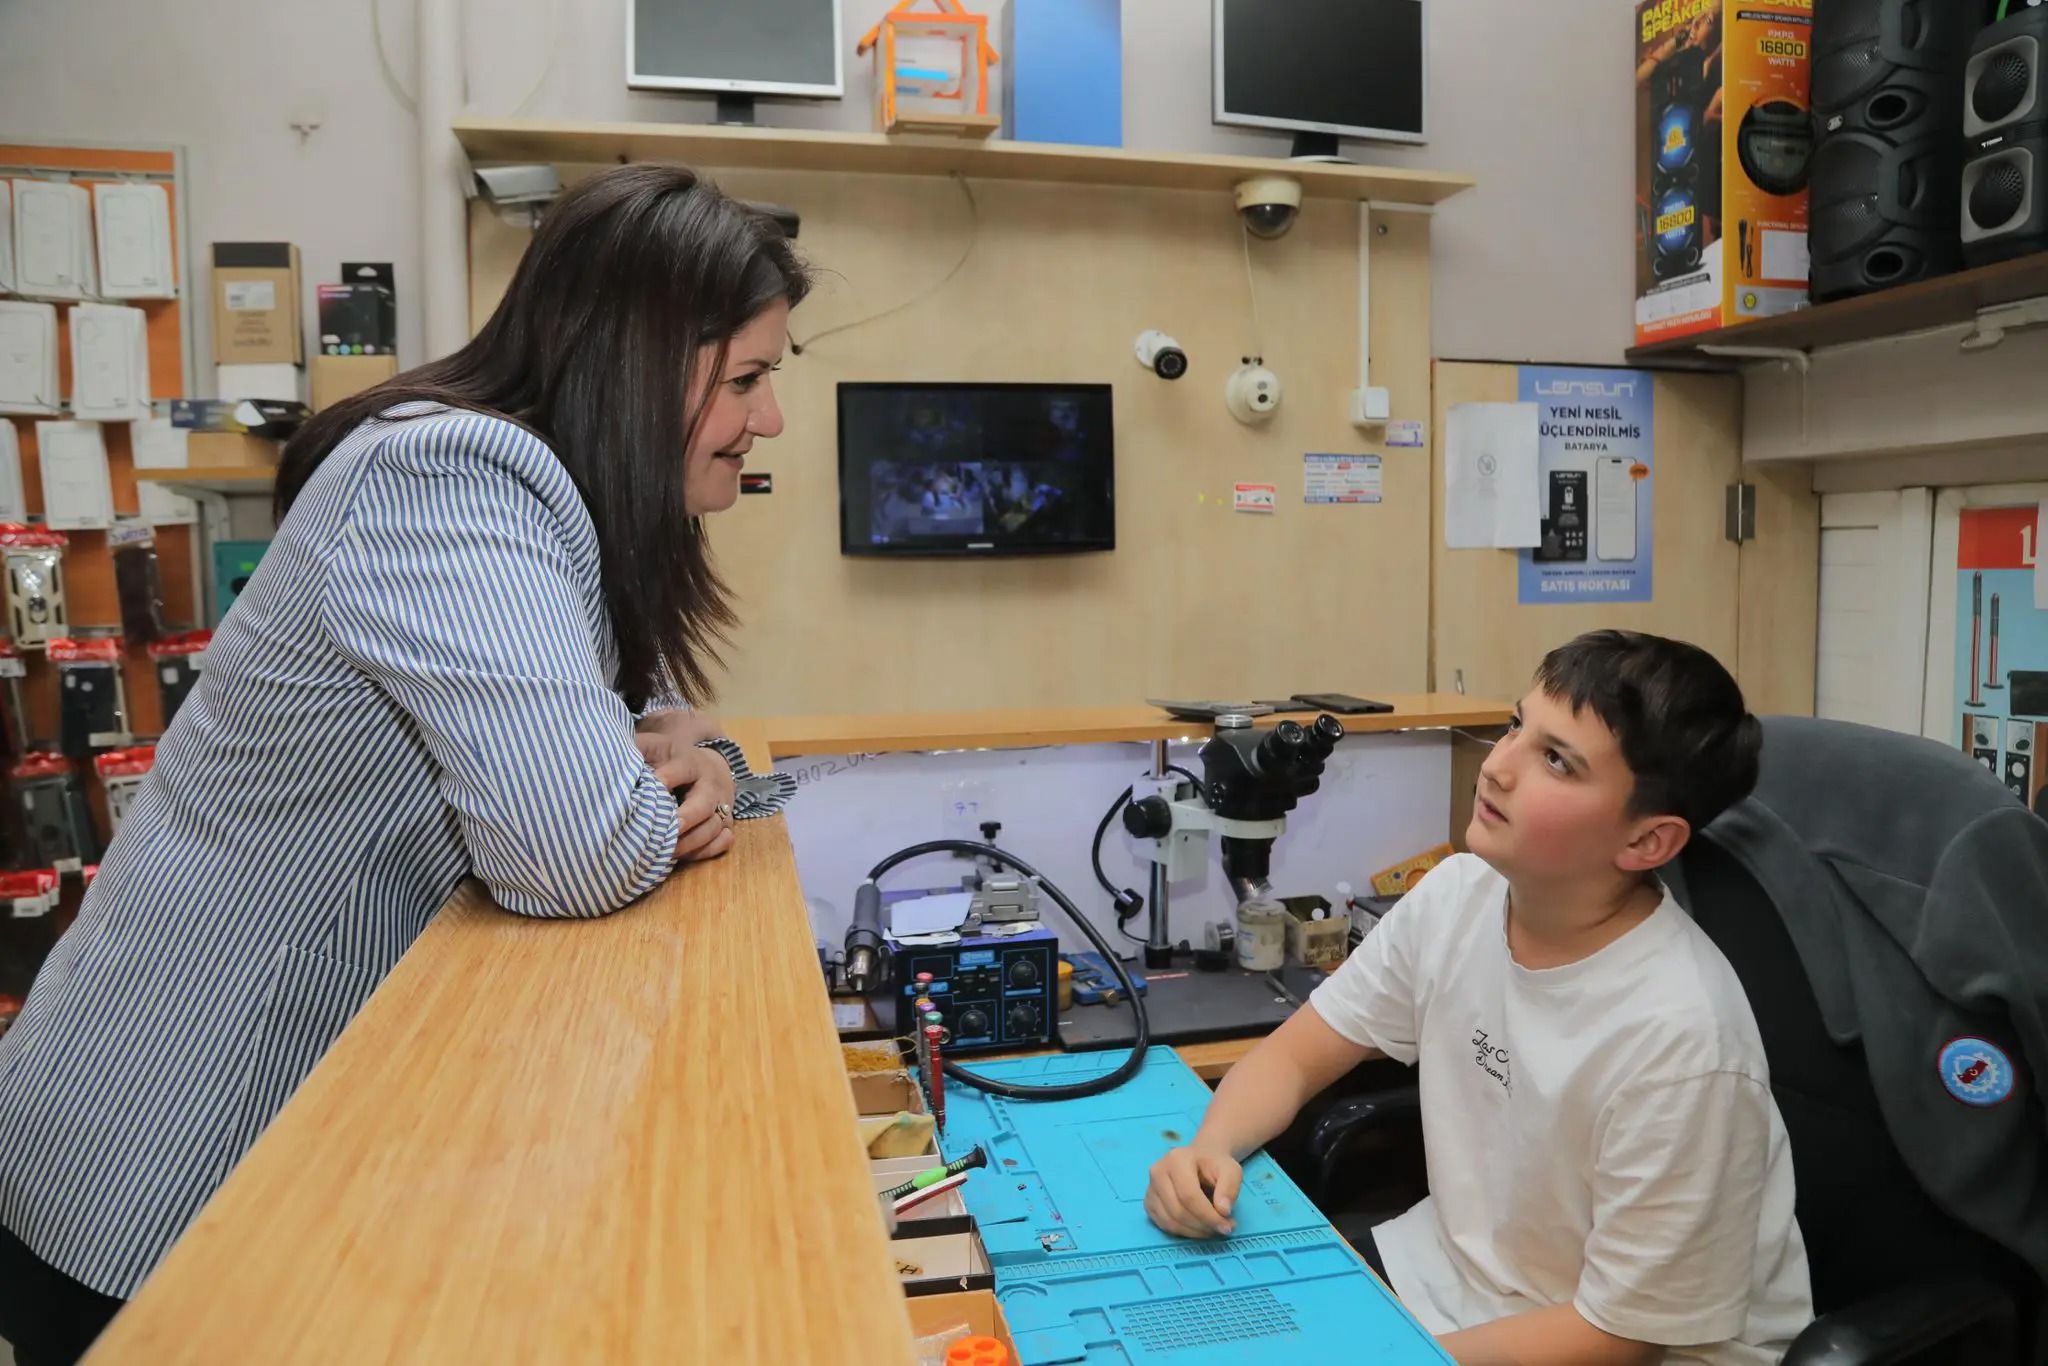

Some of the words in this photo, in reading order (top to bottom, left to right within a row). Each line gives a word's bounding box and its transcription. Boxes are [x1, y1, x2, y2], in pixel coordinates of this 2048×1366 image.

[1760, 40, 1804, 57] 16800
[1768, 57, 1796, 67] WATTS
[1550, 405, 1581, 419] YENİ
[1585, 406, 1622, 420] NESİL
[1539, 422, 1641, 439] ÜÇLENDİRİLMİŞ
[1565, 442, 1608, 452] BATARYA
[1579, 579, 1631, 592] NOKTASI
